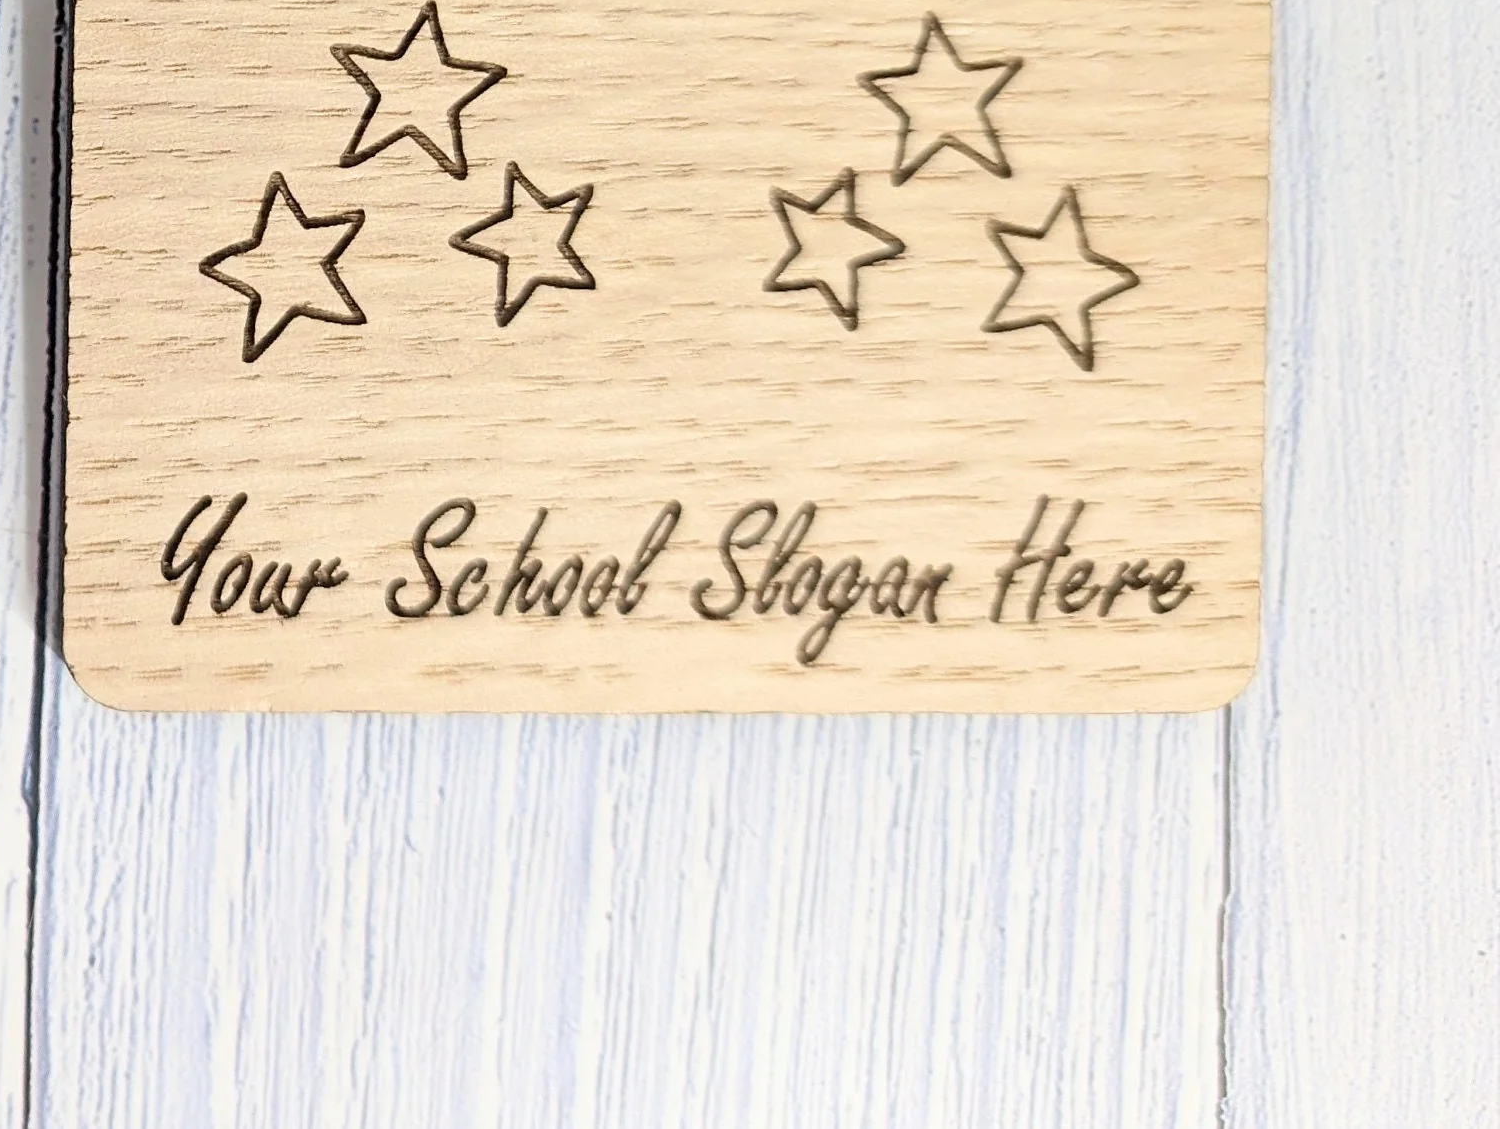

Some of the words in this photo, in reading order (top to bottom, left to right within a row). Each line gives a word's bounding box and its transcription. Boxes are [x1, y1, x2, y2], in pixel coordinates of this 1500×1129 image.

[160, 491, 349, 626] Your
[385, 496, 683, 618] School
[689, 497, 955, 667] Slogan
[988, 493, 1194, 624] Here
